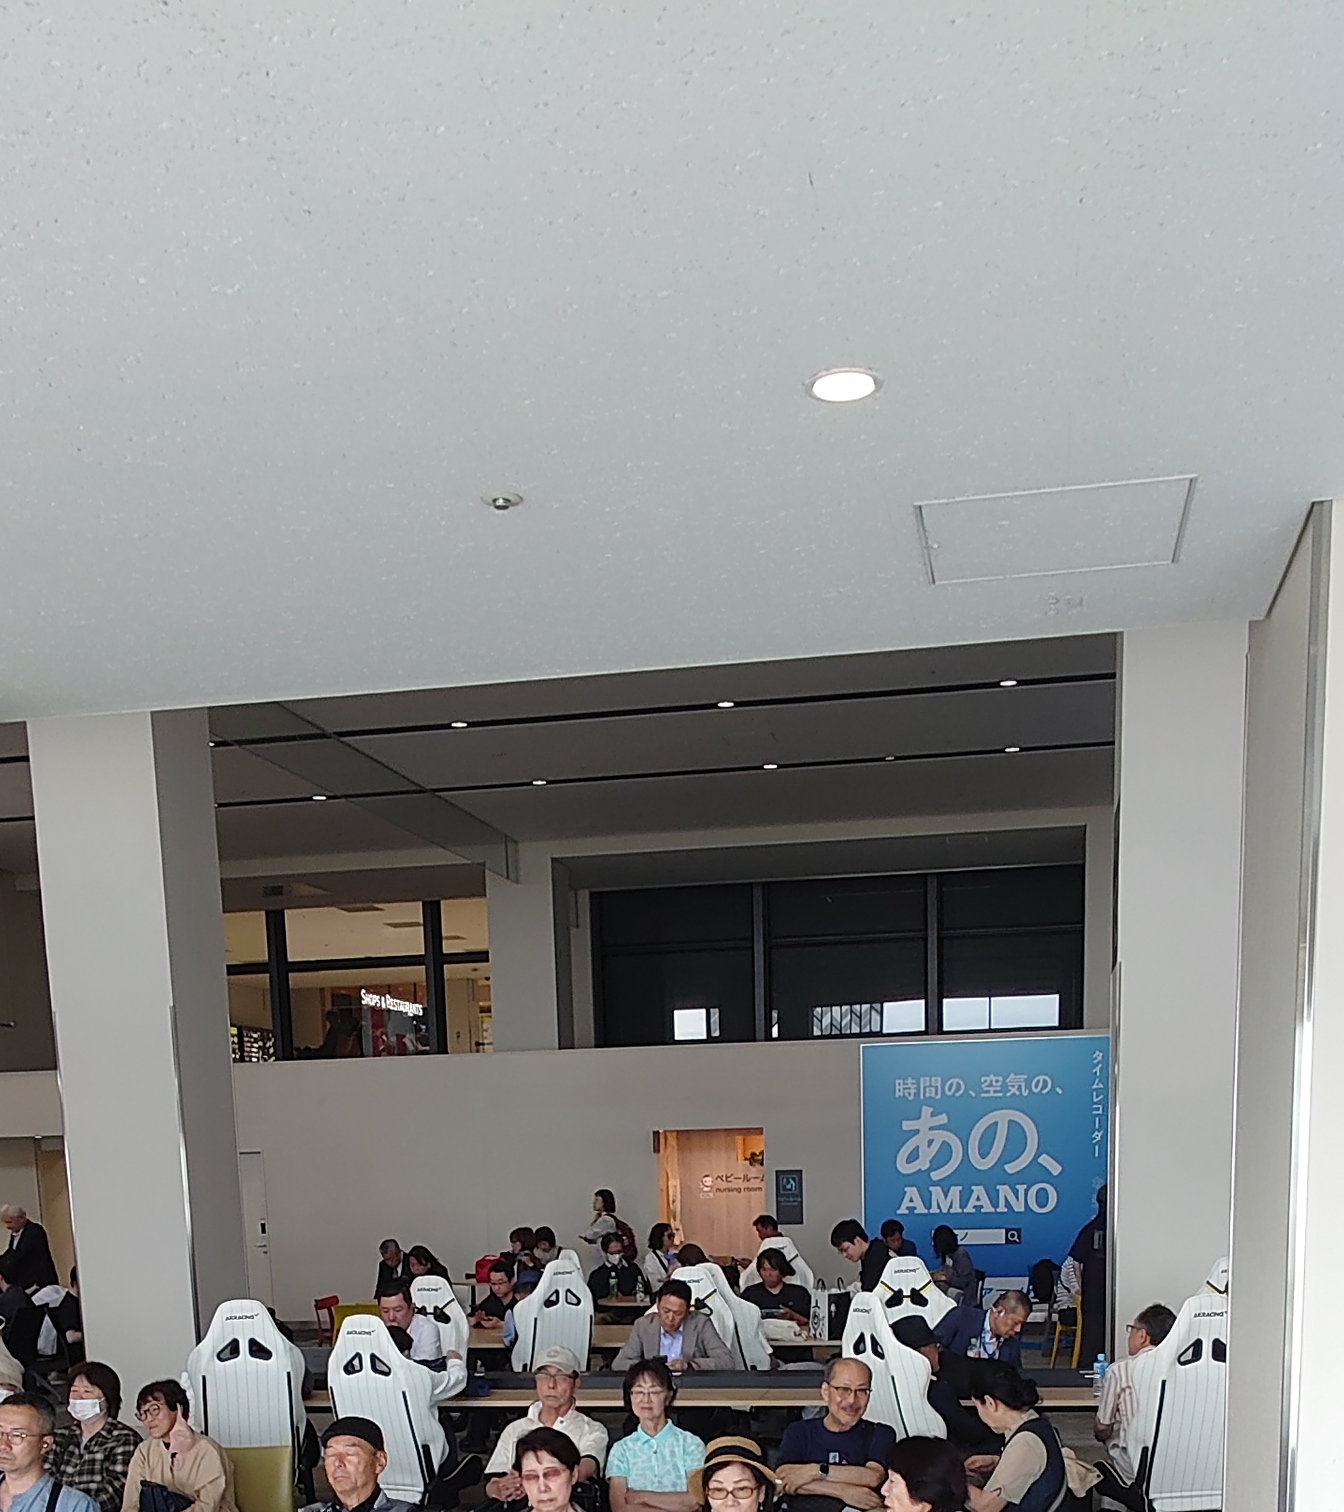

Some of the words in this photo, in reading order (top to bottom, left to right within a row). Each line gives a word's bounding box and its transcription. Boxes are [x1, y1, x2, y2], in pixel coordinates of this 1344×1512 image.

[894, 1073, 1064, 1101] 時間の、空気の、
[1091, 1050, 1104, 1157] タイムレコーダー
[896, 1105, 1063, 1181] あの、
[896, 1183, 1058, 1214] AMANO
